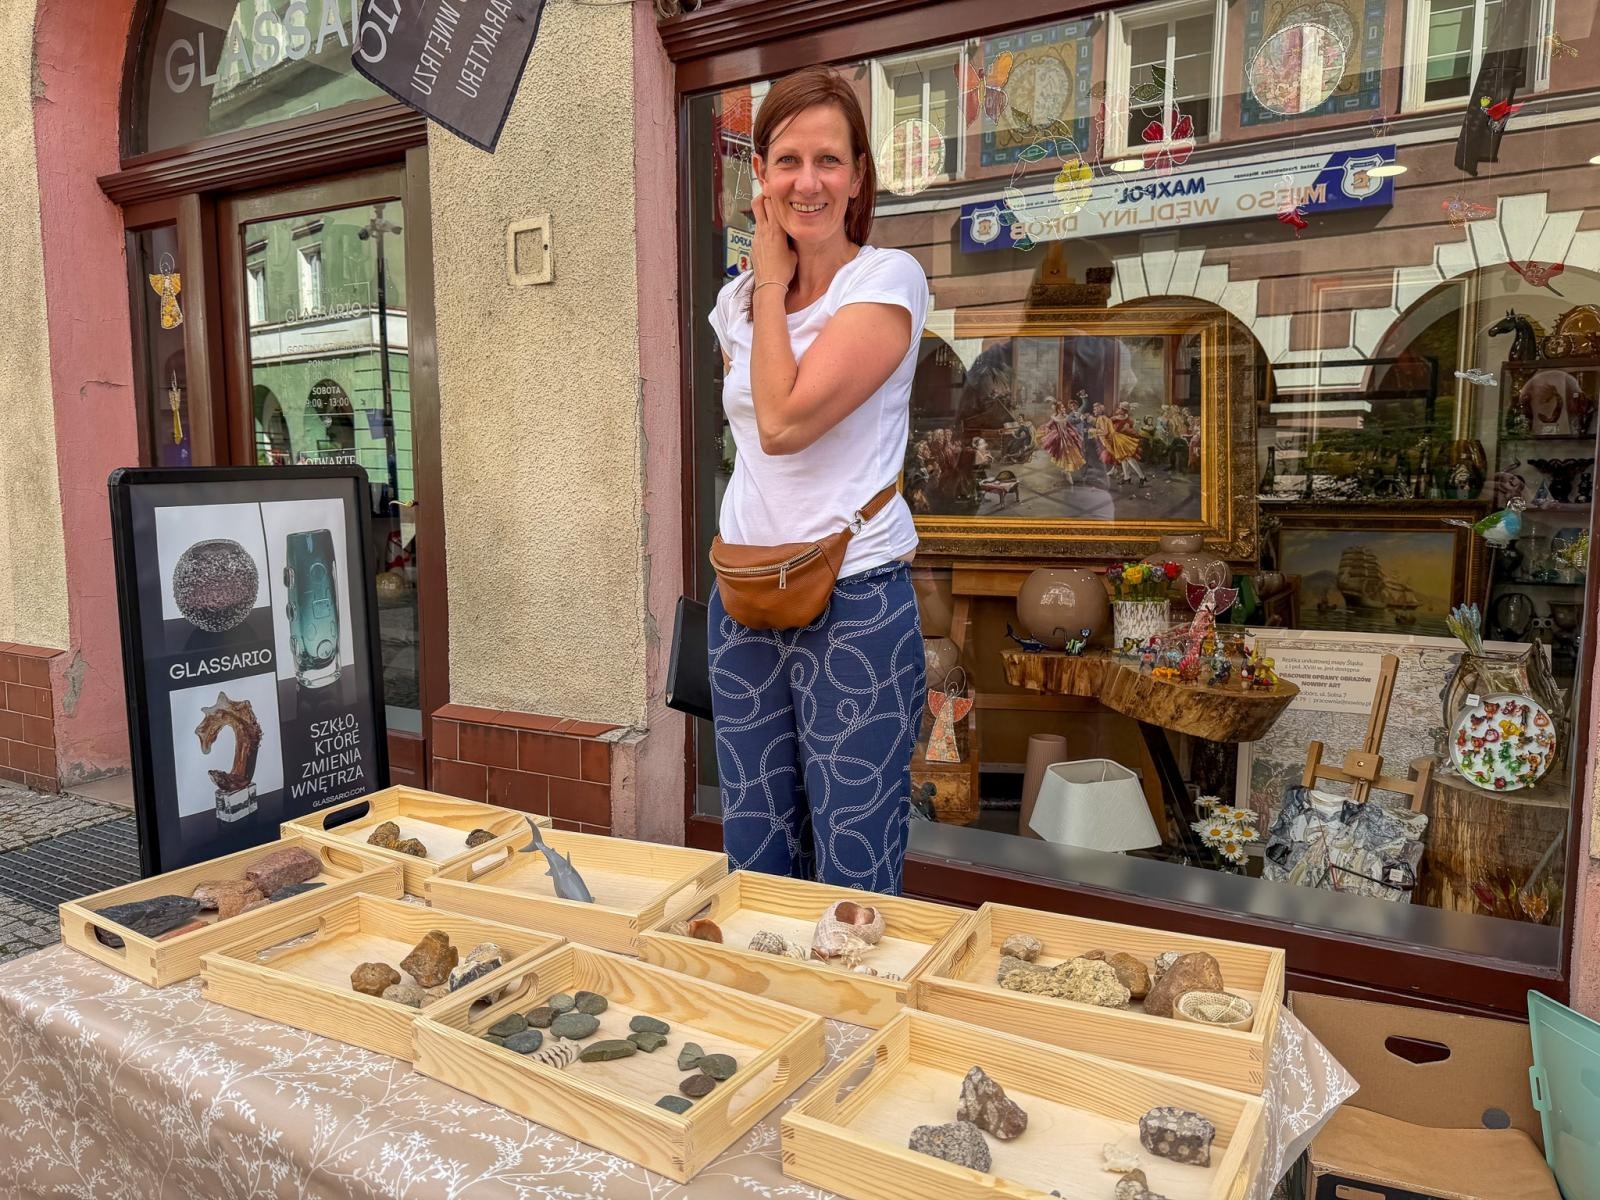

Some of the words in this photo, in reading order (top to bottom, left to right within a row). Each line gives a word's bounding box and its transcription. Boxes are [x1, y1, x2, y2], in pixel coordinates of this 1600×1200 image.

[312, 386, 341, 395] SOBOTA
[169, 648, 273, 680] GLASSARIO
[310, 713, 359, 738] SZKŁO,
[314, 729, 360, 756] KTÓRE
[301, 747, 362, 779] ZMIENIA
[291, 764, 364, 799] WNĘTRZA
[312, 786, 366, 808] GLASSARIO.COM
